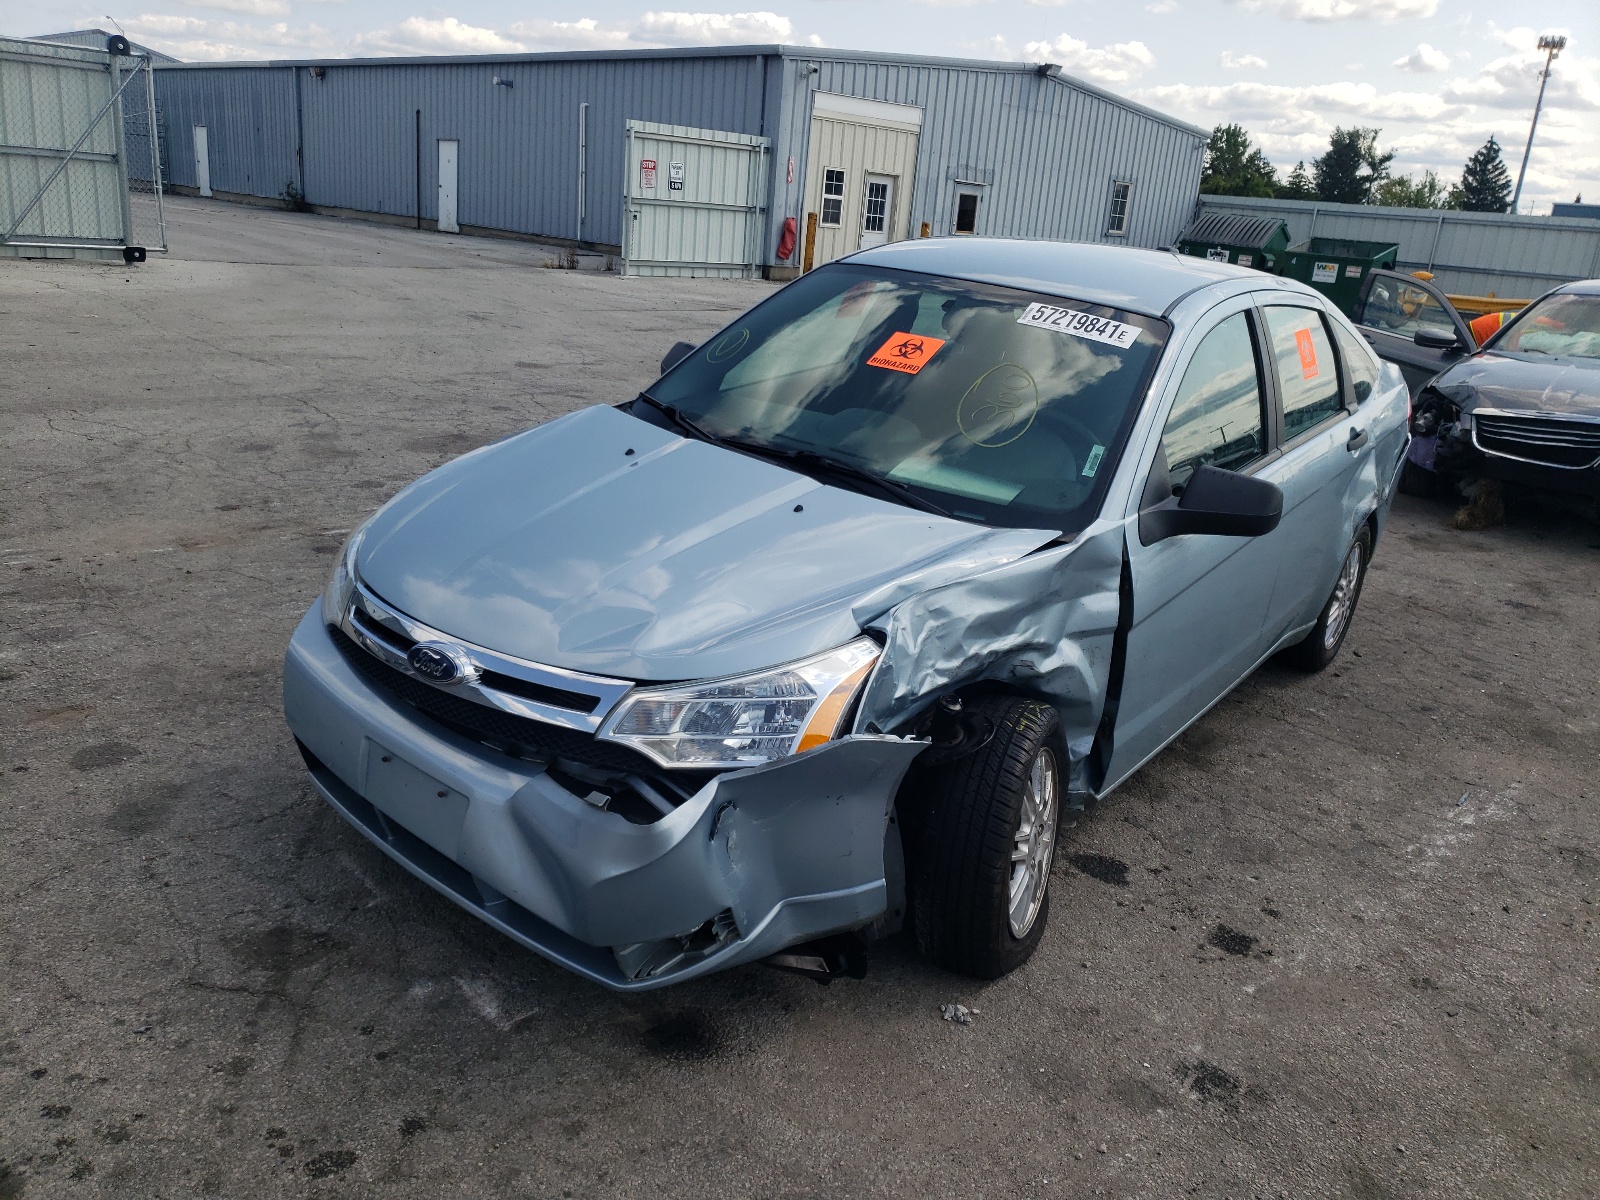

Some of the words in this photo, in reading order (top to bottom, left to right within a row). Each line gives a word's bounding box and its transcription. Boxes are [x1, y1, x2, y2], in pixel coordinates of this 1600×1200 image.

[642, 161, 656, 169] STOP
[870, 357, 920, 372] BIOHAZARD
[413, 649, 447, 677] Ford
